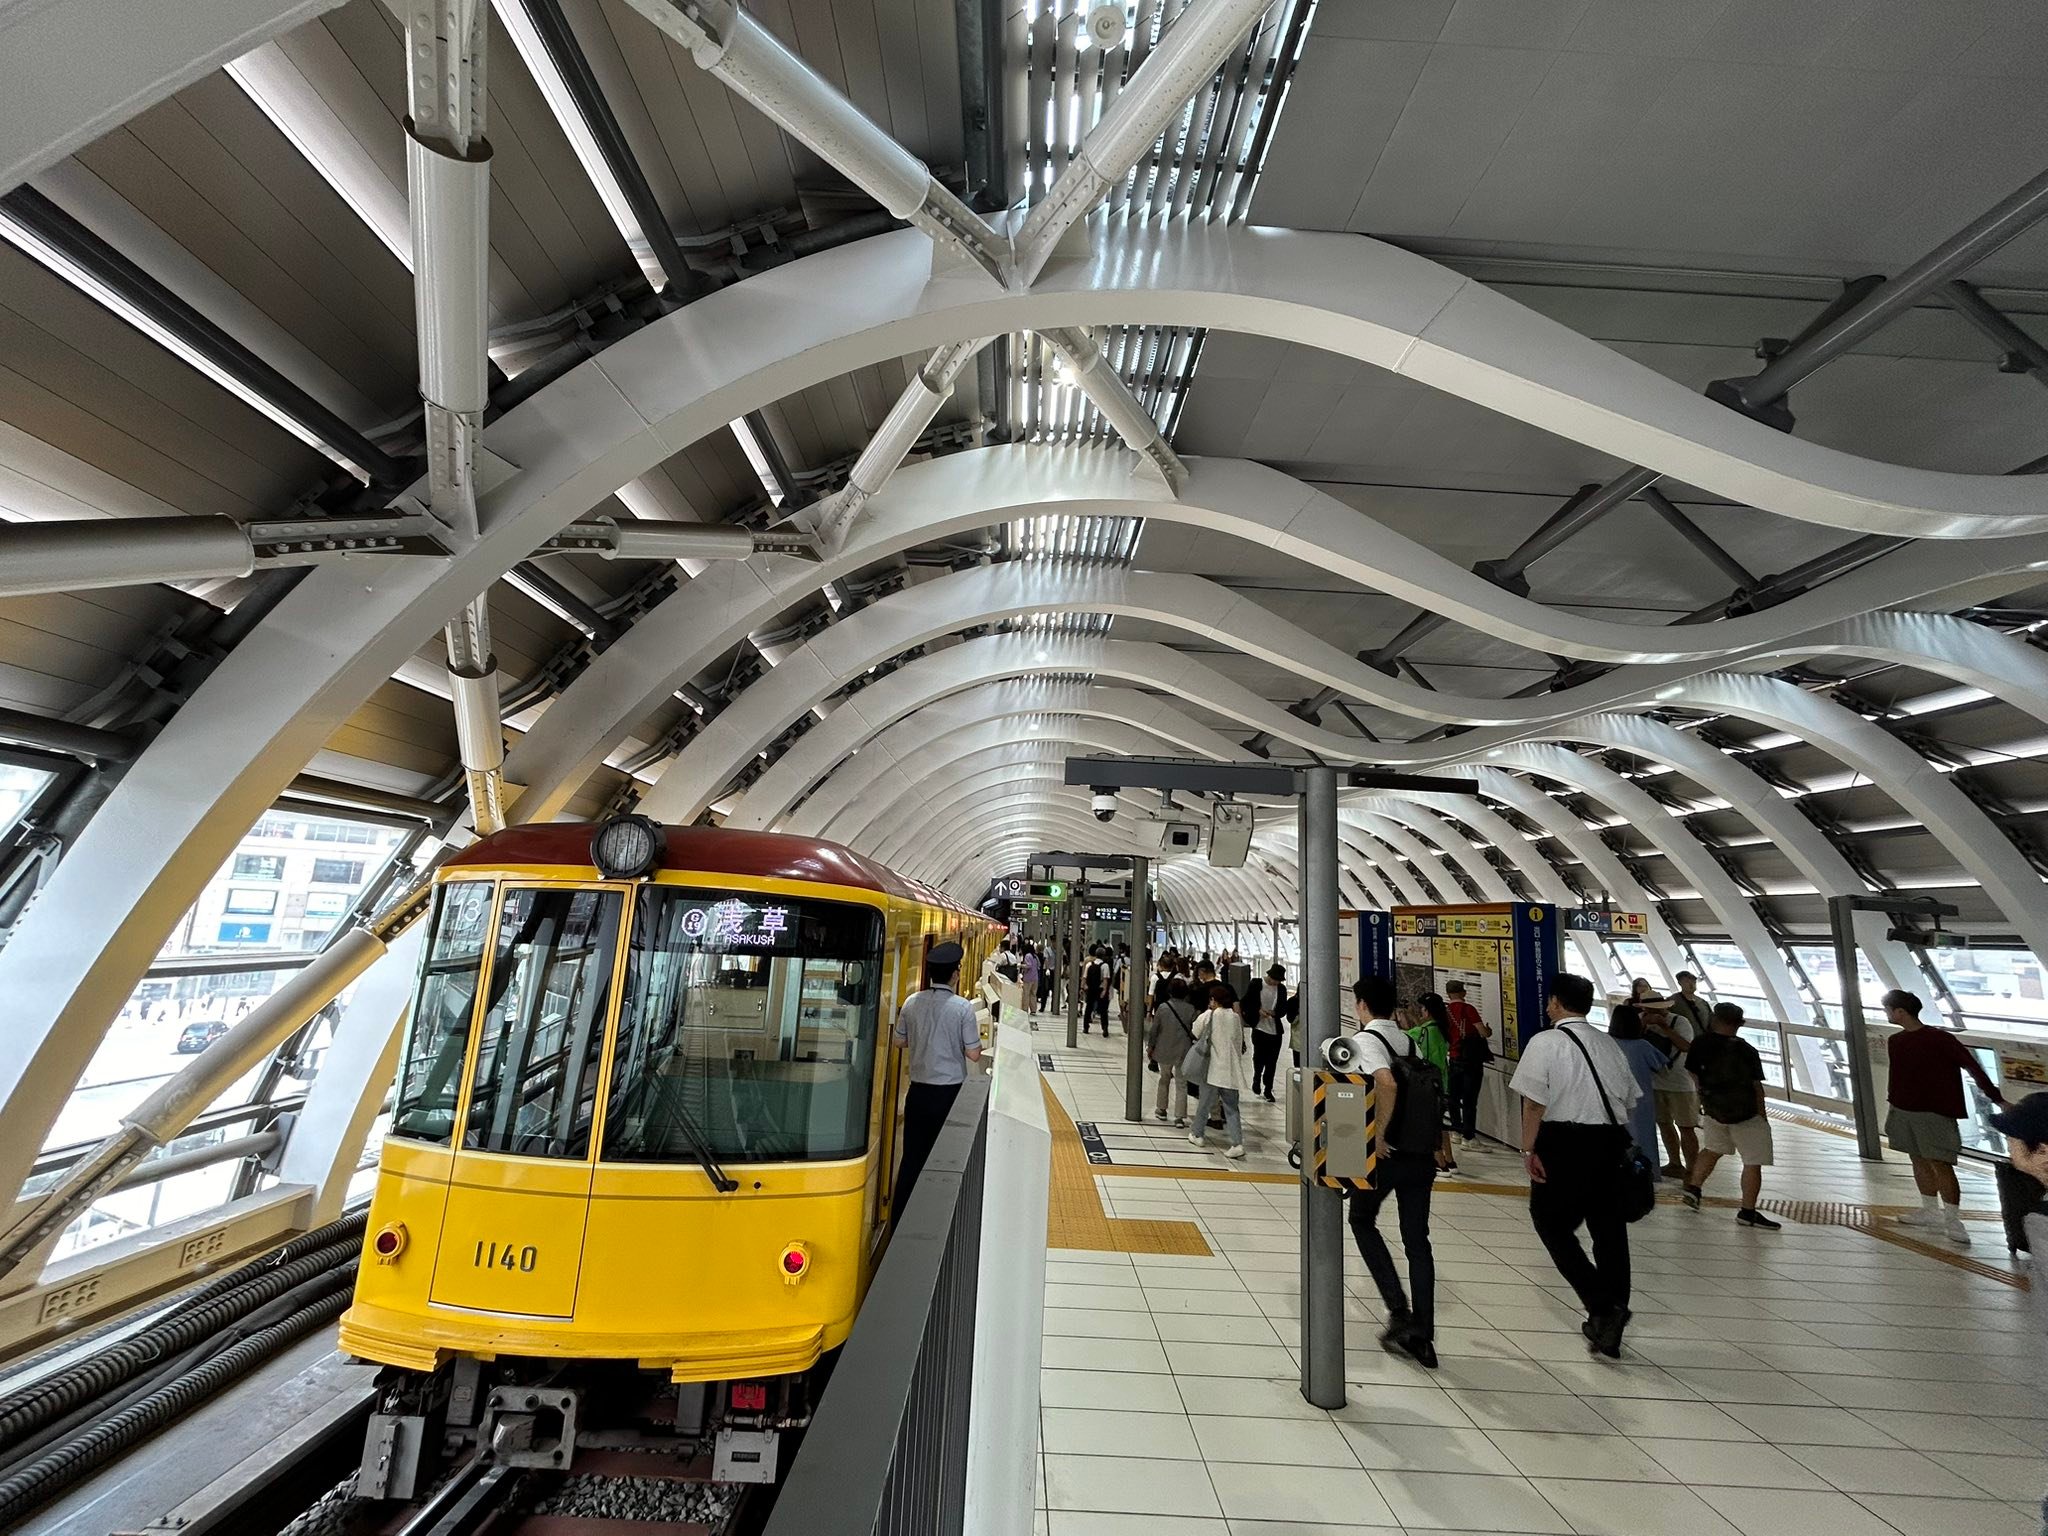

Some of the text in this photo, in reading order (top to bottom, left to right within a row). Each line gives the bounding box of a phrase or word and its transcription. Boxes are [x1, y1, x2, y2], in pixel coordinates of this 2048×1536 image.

[716, 904, 789, 937] 浅草
[724, 933, 776, 946] ASAKUSA
[474, 1240, 538, 1273] 1140
